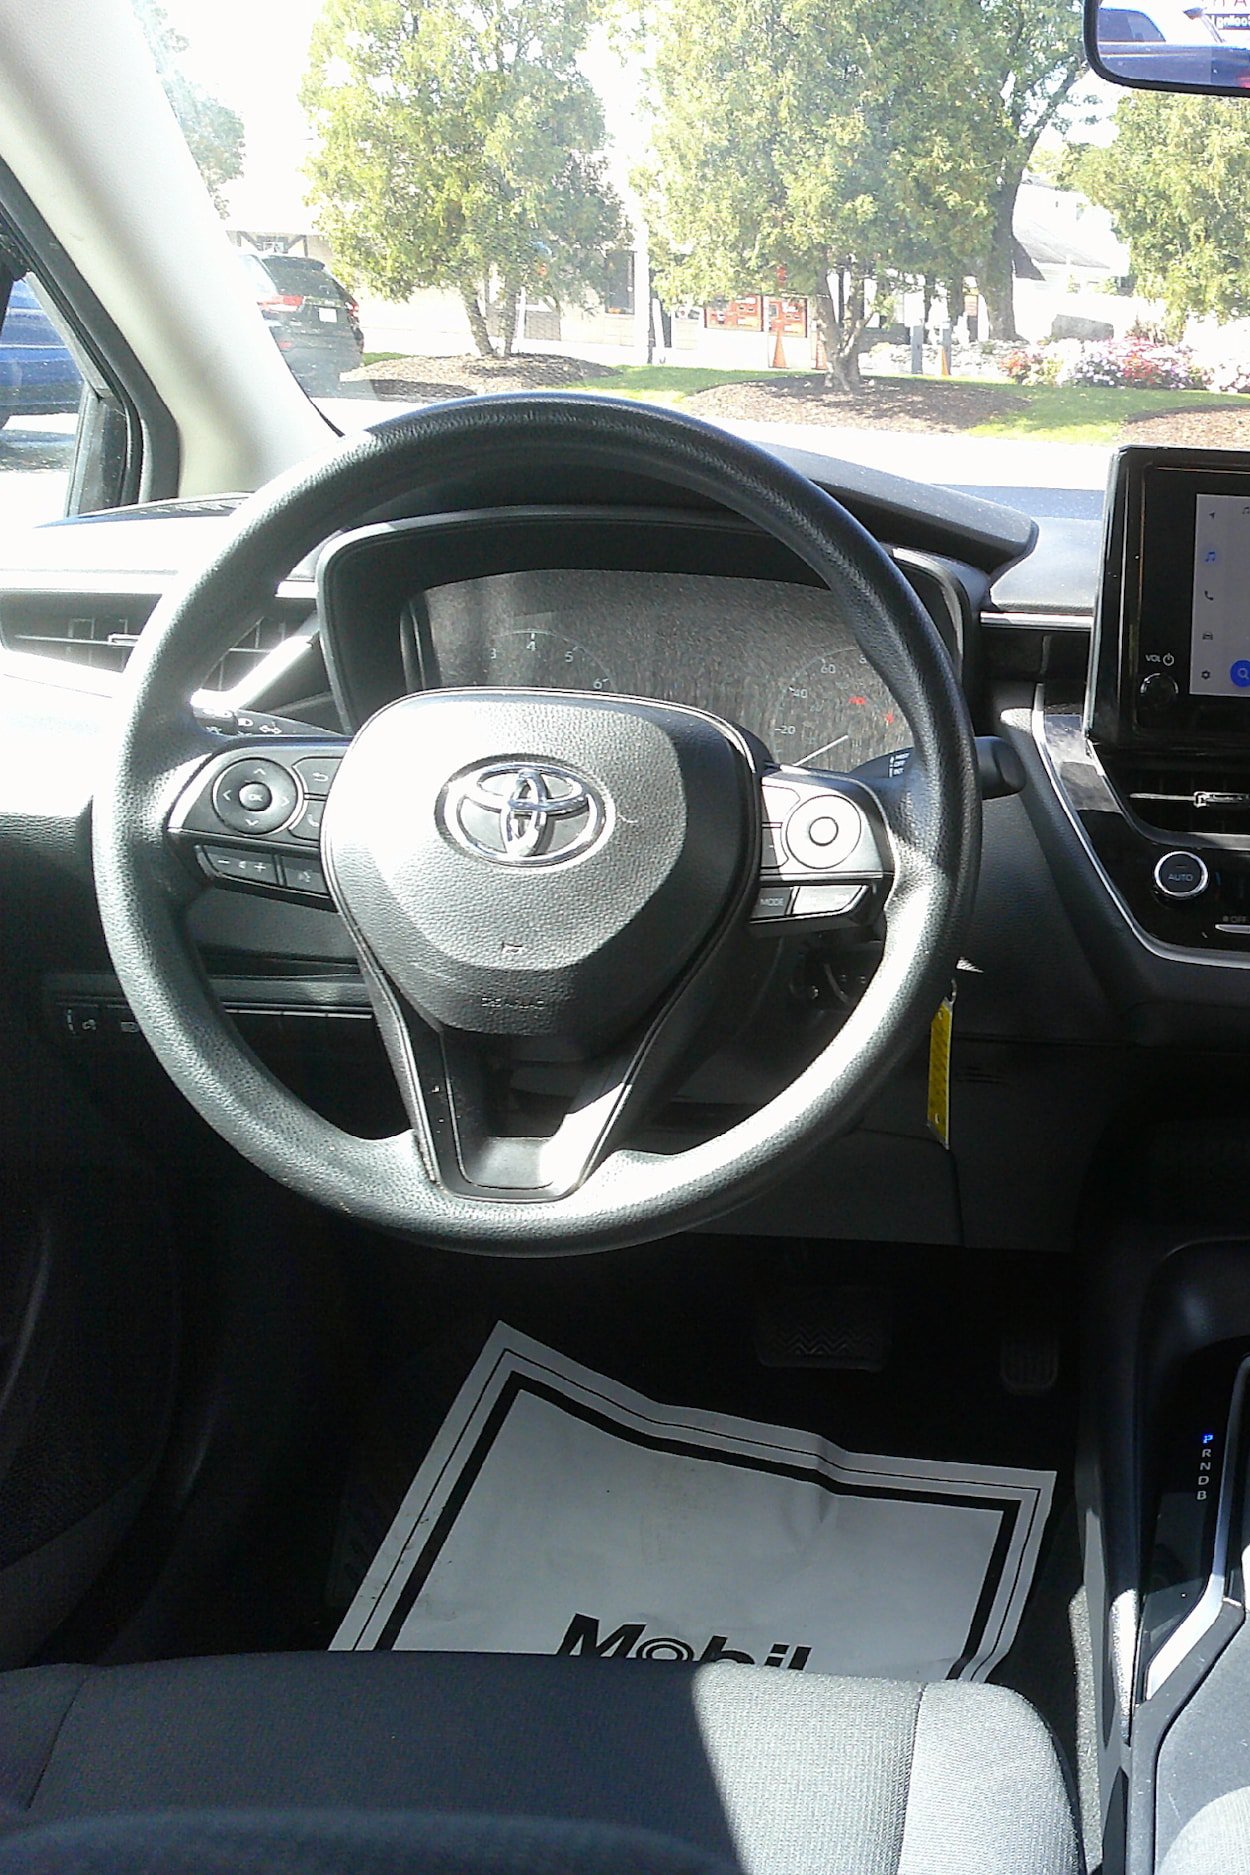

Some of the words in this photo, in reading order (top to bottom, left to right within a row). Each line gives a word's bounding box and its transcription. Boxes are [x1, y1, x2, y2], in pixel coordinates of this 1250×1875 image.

[526, 640, 536, 652] 4
[564, 650, 574, 663] 5
[820, 663, 836, 674] 60
[593, 677, 603, 690] 6
[780, 725, 796, 735] 20
[1168, 873, 1194, 882] AUTO
[760, 897, 784, 906] MODE
[1230, 915, 1247, 924] OFF
[1202, 1434, 1214, 1444] P
[1202, 1448, 1212, 1458] R
[1200, 1462, 1212, 1471] N
[1198, 1476, 1210, 1486] D
[1196, 1490, 1207, 1501] B
